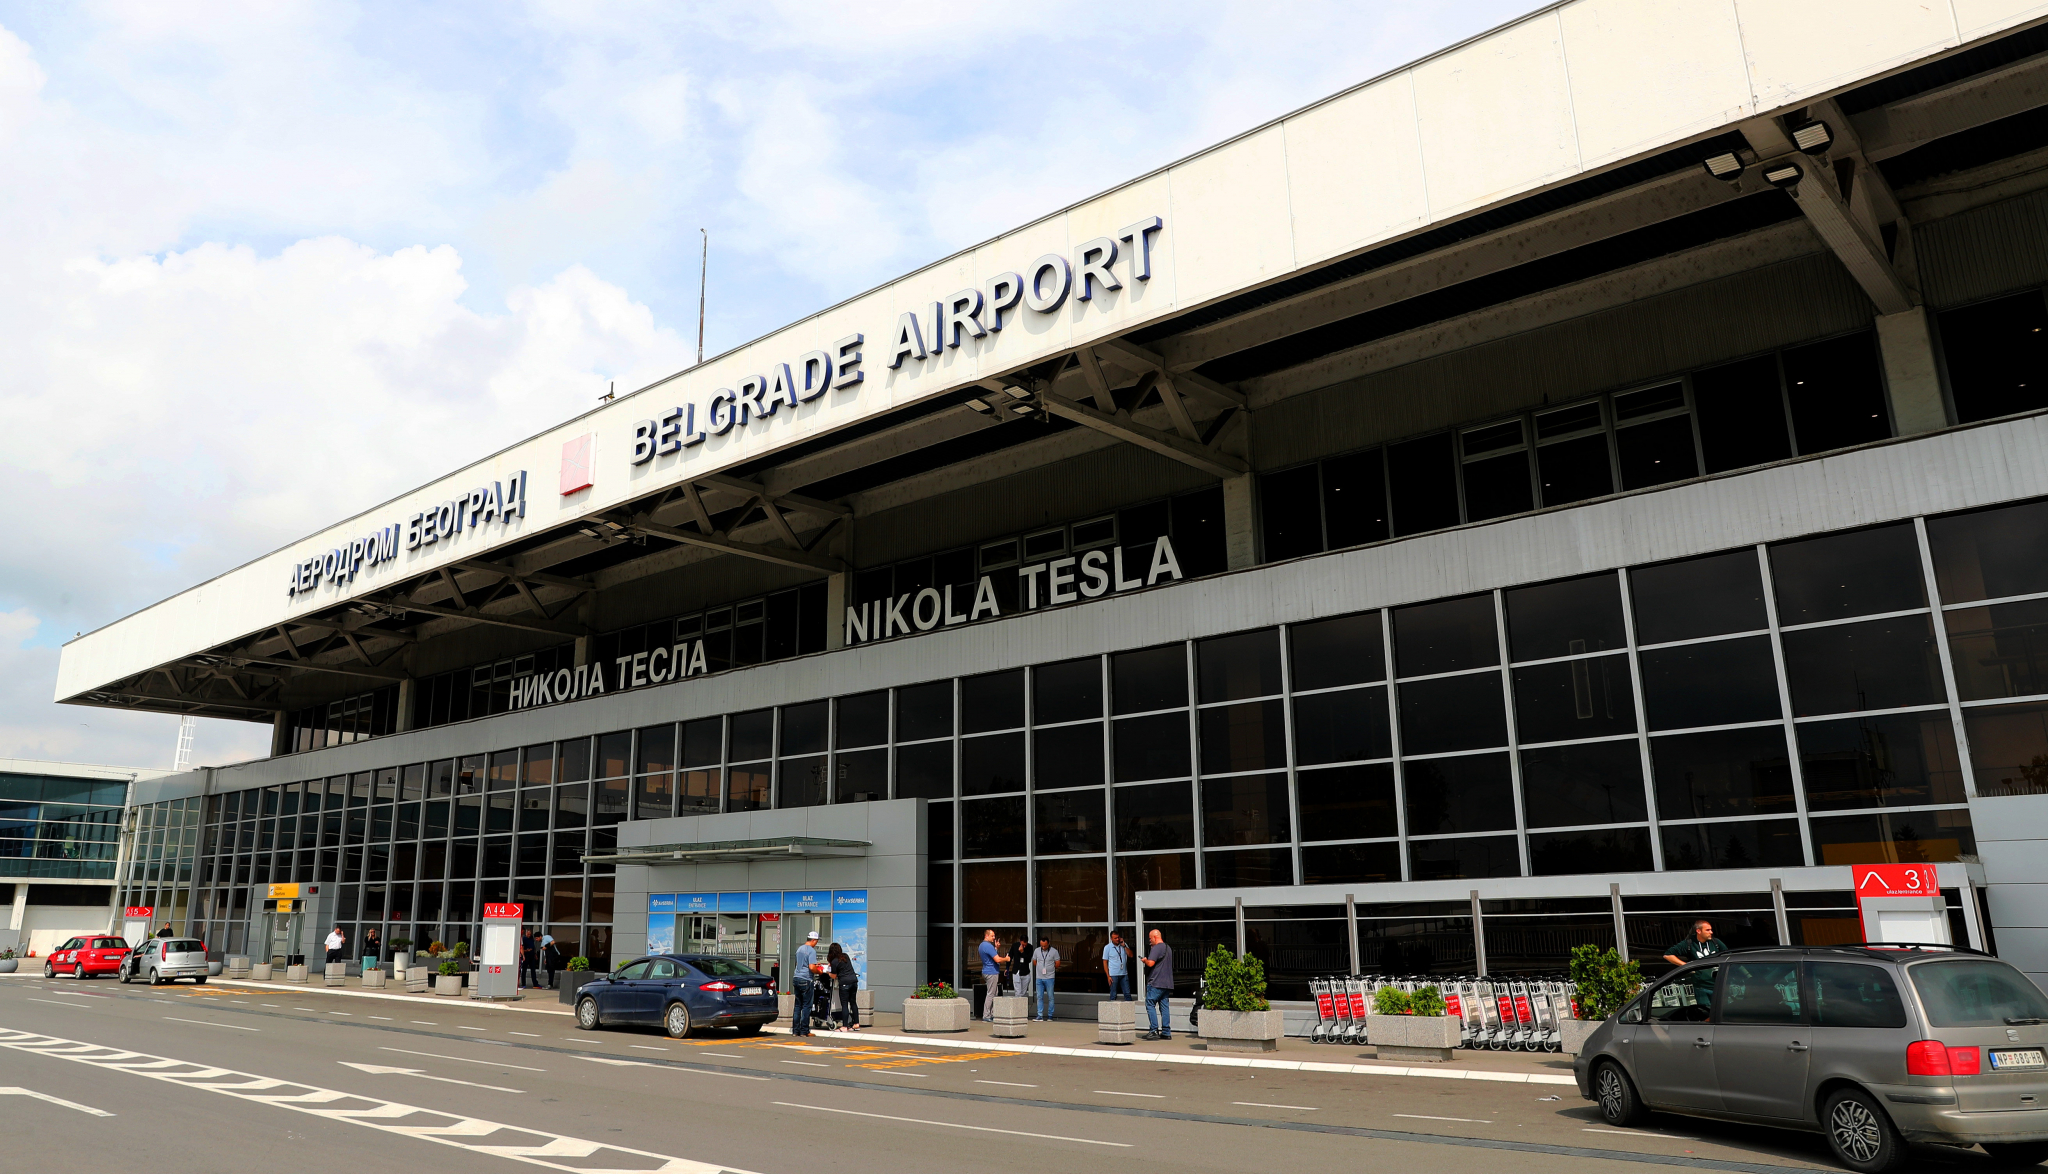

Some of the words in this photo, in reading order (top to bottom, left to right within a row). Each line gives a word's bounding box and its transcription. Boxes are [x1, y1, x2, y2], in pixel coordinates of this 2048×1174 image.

[630, 333, 864, 466] BELGRADE
[887, 215, 1162, 370] AIRPORT
[287, 523, 400, 597] АЕРОДРОМ
[406, 470, 527, 551] БЕОГРАД
[845, 576, 1000, 645] NIKOLA
[1019, 535, 1183, 610] TESLA
[509, 662, 604, 710] НИКОЛА
[616, 640, 707, 689] ТЕСЛА
[499, 906, 505, 914] 4
[1904, 869, 1921, 889] 3
[1996, 1053, 2008, 1065] NP
